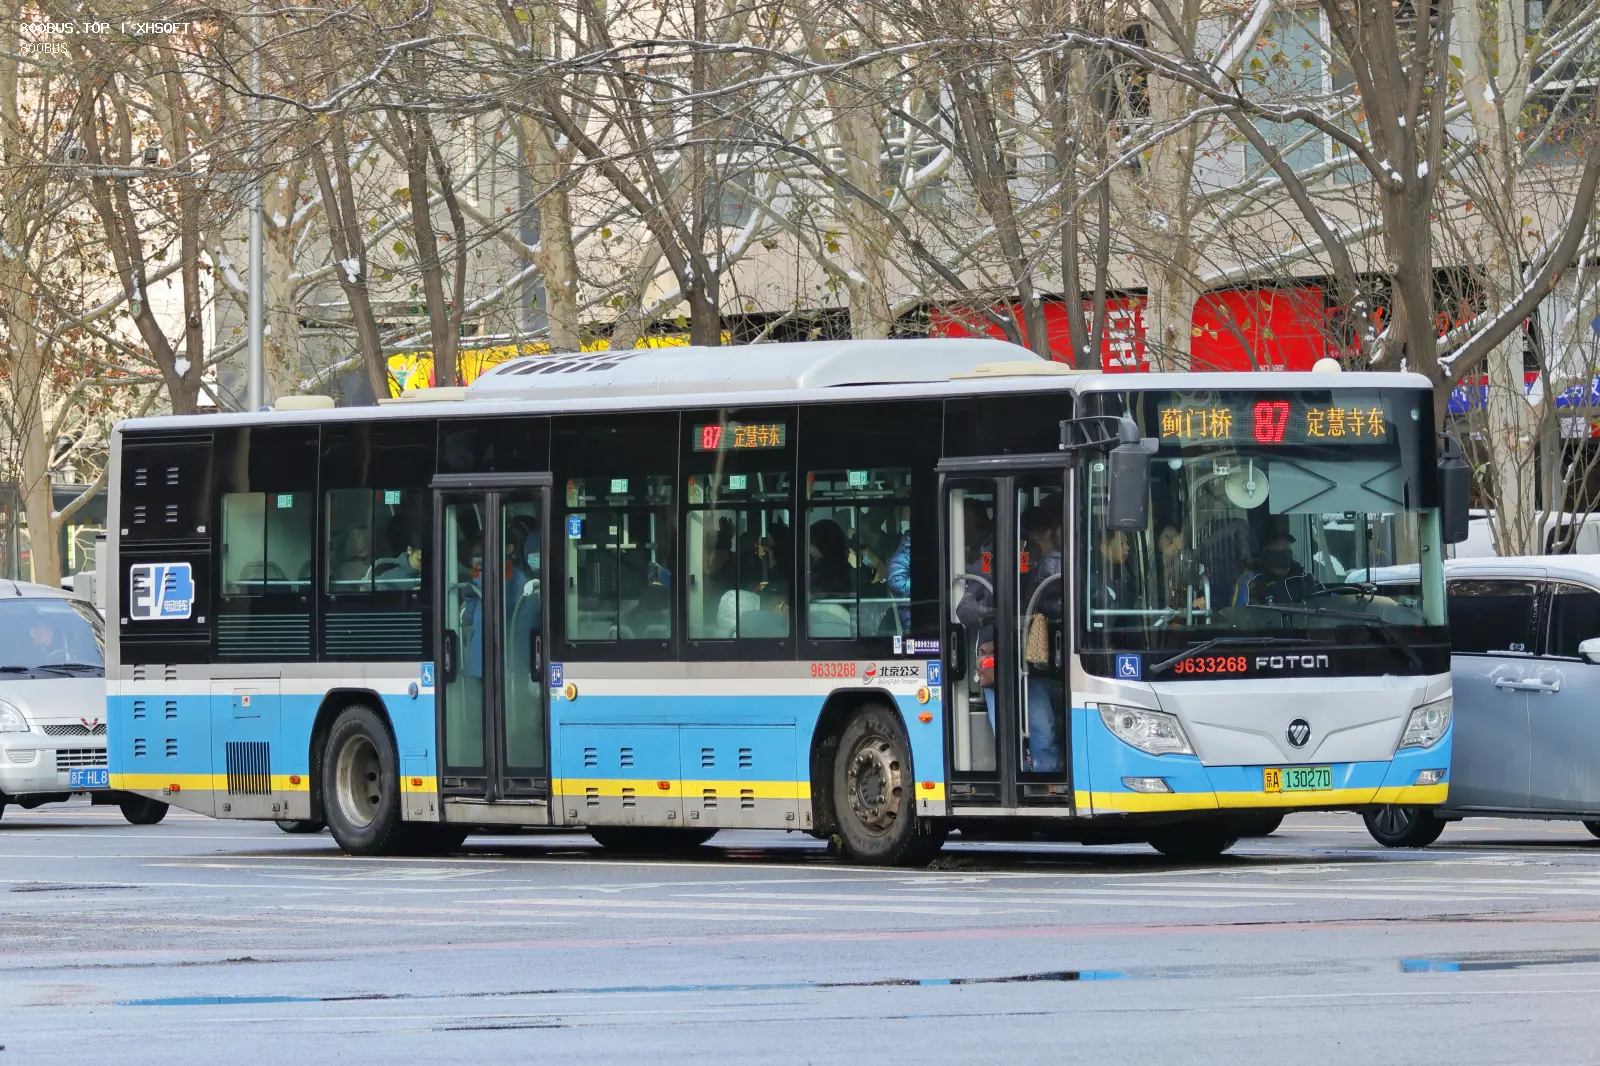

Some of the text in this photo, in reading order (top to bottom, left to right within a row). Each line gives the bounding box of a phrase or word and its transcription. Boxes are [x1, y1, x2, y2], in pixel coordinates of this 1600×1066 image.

[1161, 408, 1233, 438] 蓟门桥
[1254, 402, 1290, 443] 87
[1306, 407, 1386, 438] 定慧寺东
[702, 426, 722, 449] 87
[733, 424, 780, 448] 定慧寺东
[811, 663, 856, 677] 9633268
[879, 666, 919, 676] 北京公交
[1174, 655, 1329, 673] 9633268 FOTON
[1265, 770, 1331, 789] 京A 13027D
